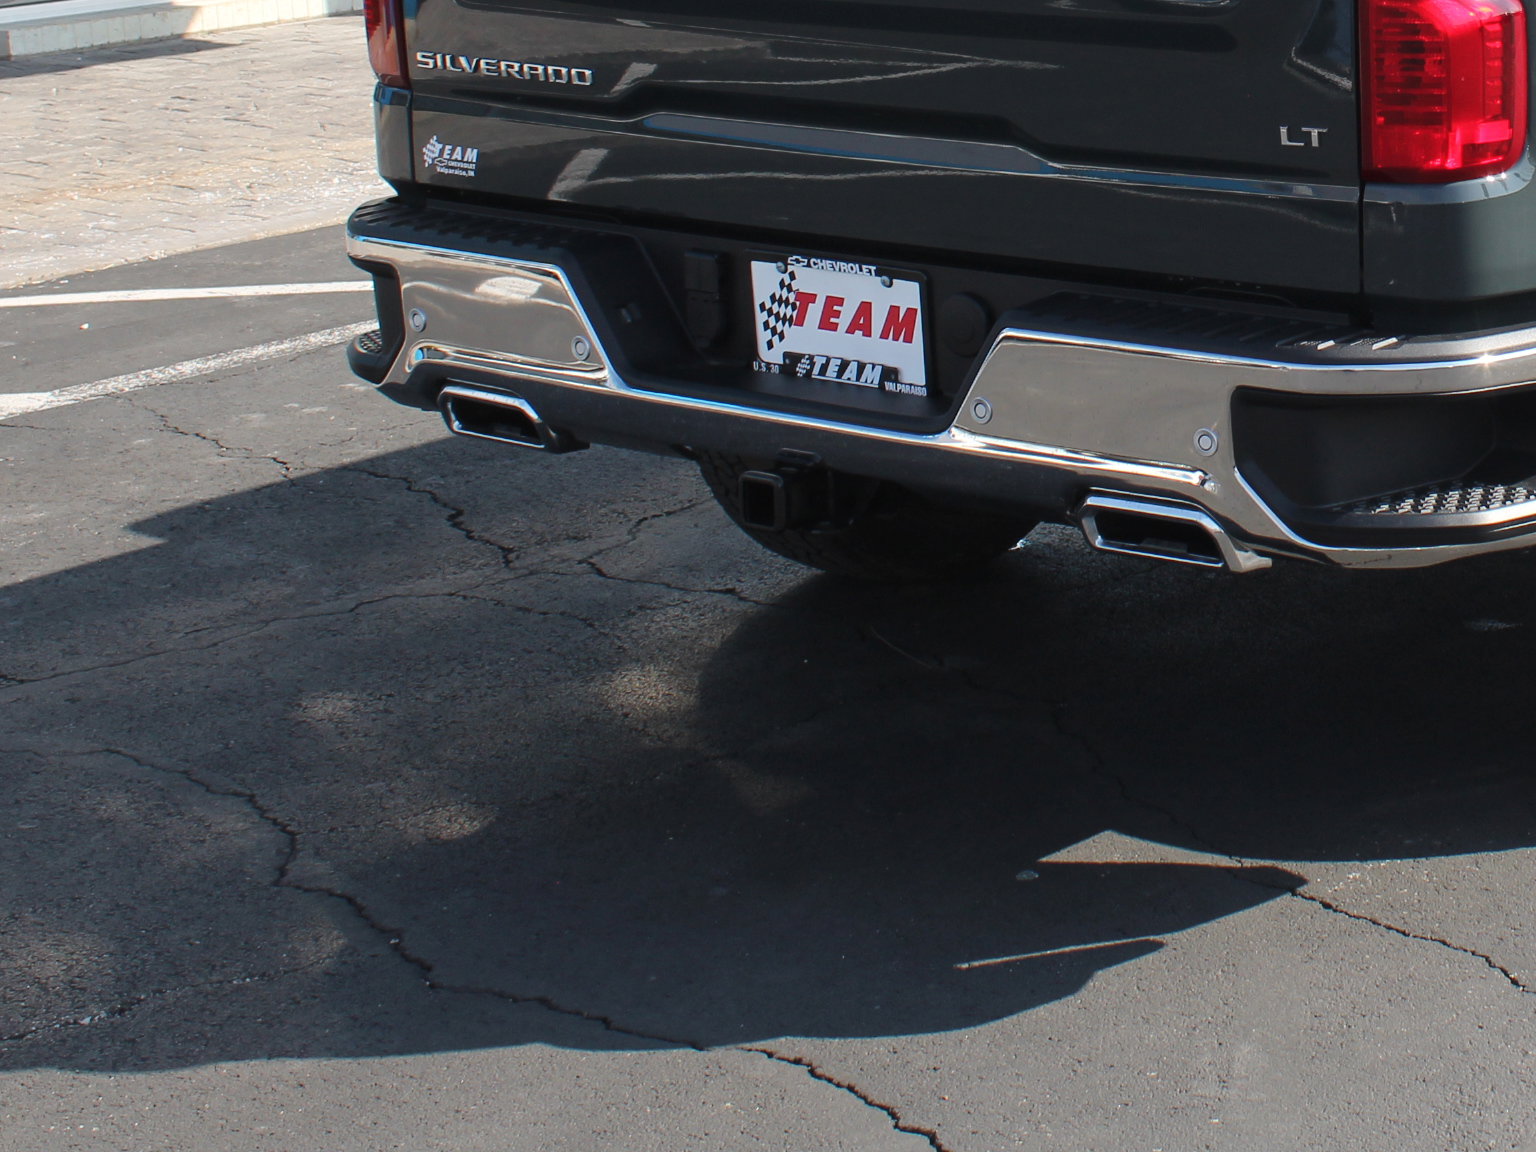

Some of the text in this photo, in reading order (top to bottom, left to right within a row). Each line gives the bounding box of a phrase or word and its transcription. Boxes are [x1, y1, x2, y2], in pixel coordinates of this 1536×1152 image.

[416, 51, 593, 85] SILVERADO
[1280, 126, 1328, 147] LT
[434, 143, 479, 163] TEAM
[447, 160, 476, 170] CHEVROLET
[810, 257, 877, 276] CHEVROLET
[793, 291, 918, 344] TEAM
[753, 361, 780, 374] U.S. 30
[811, 355, 883, 385] TEAM
[884, 381, 927, 397] VALPARAISO
